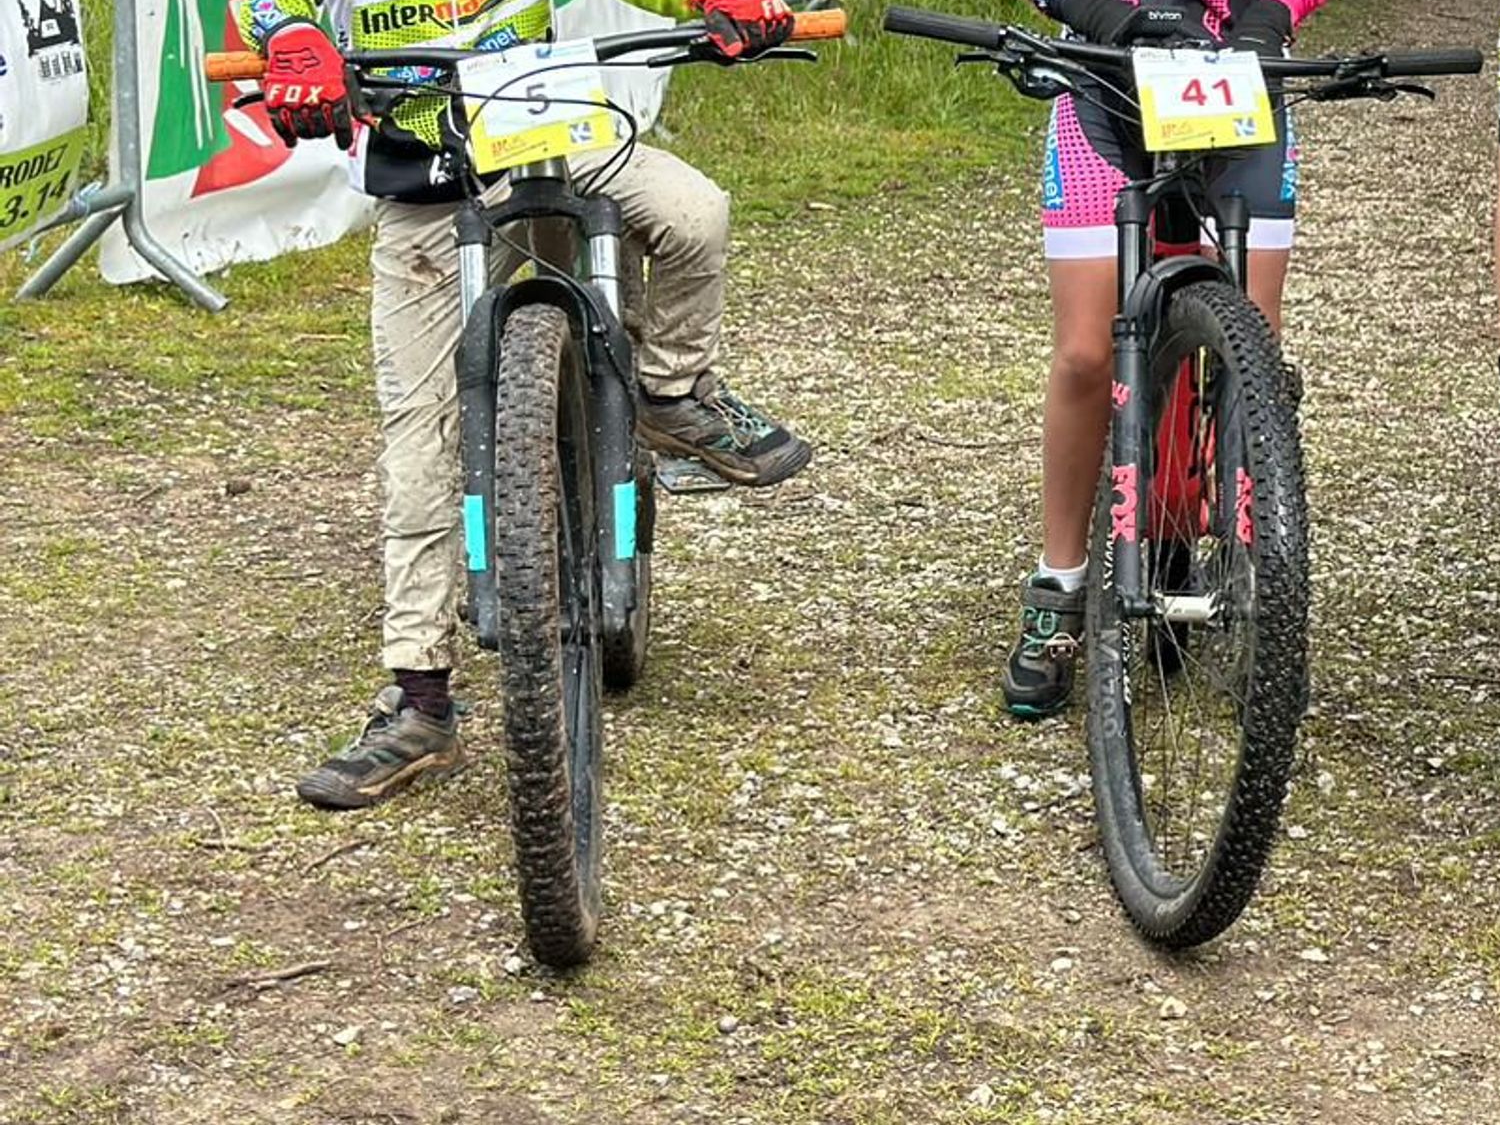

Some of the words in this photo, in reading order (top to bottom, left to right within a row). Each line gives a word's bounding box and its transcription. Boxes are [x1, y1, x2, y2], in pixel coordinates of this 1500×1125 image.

[269, 83, 324, 105] FOX
[526, 82, 550, 115] 5
[1181, 78, 1234, 107] 41
[1111, 463, 1138, 543] FOX
